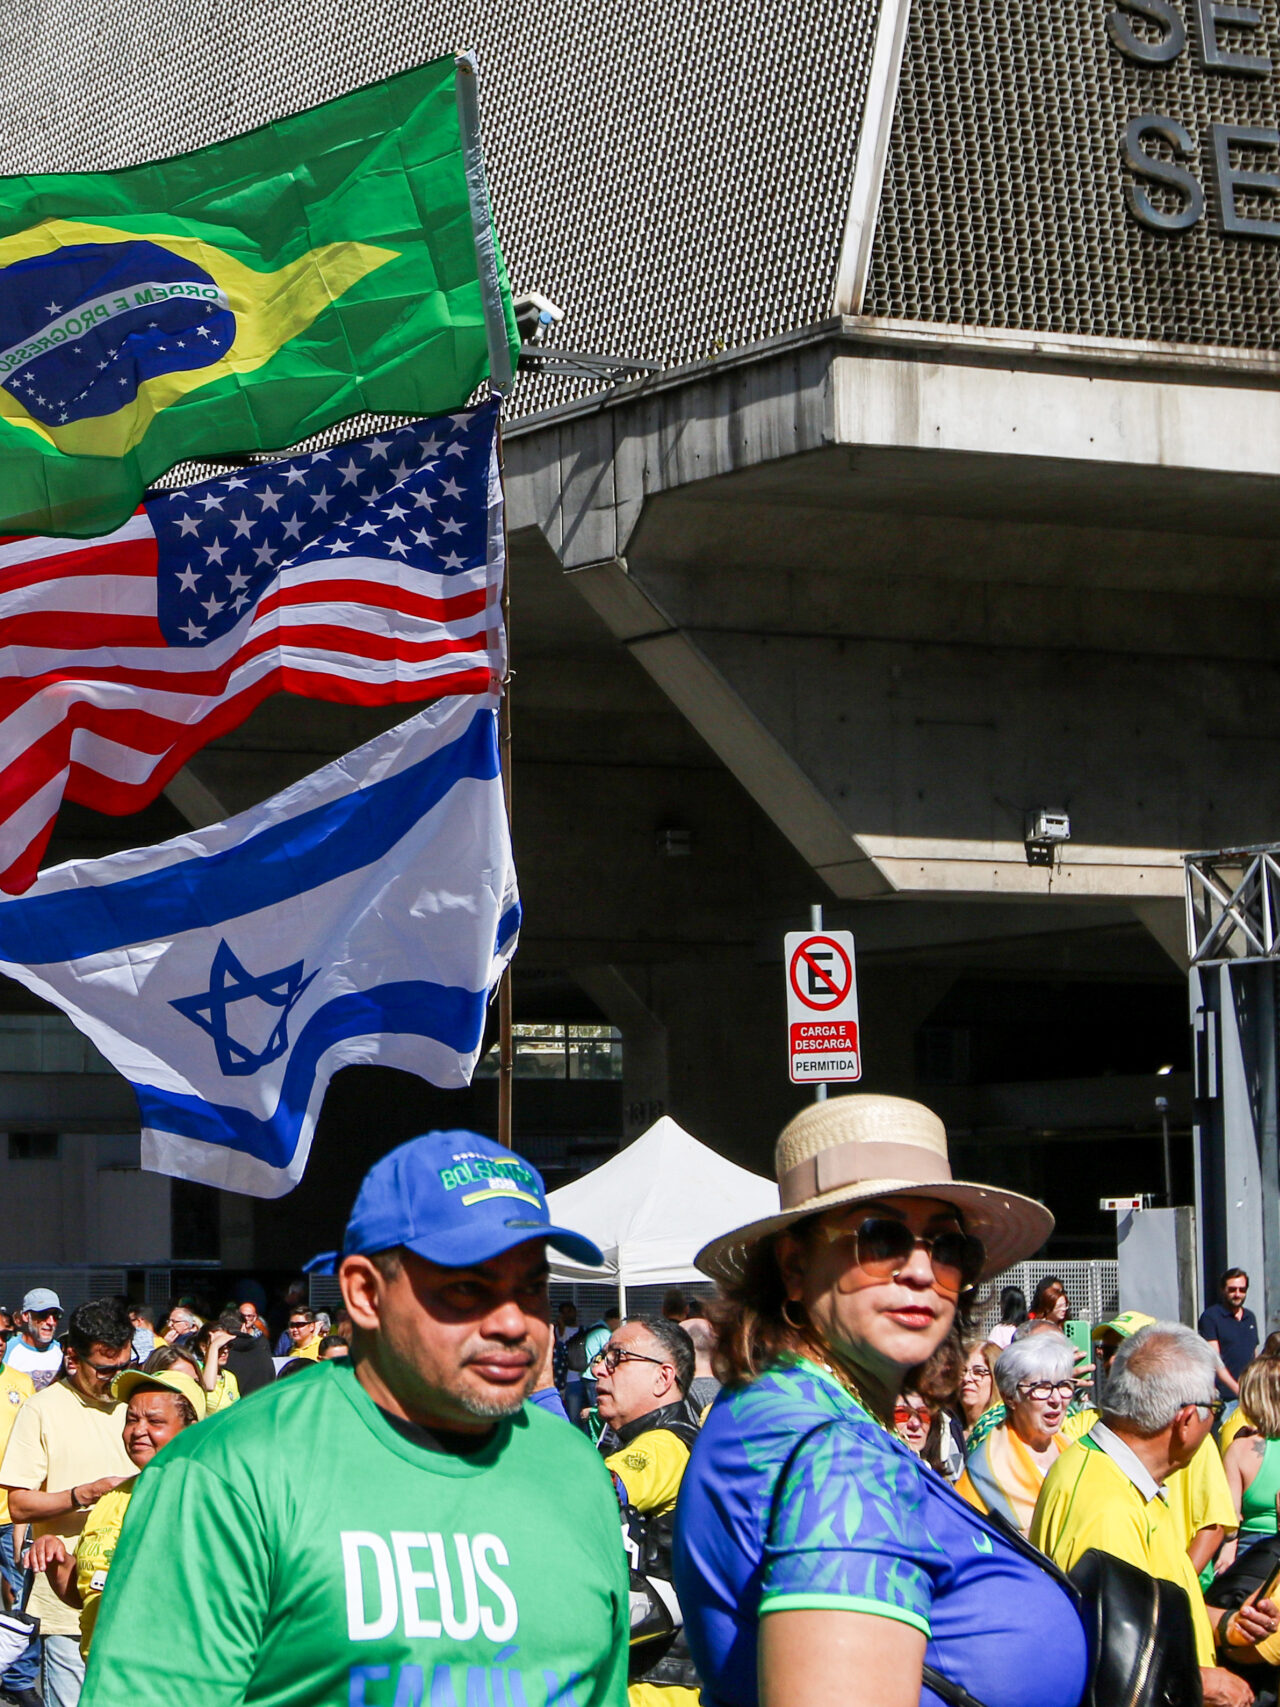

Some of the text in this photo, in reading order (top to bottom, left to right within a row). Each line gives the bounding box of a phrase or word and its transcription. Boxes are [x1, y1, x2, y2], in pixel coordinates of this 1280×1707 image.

[800, 1025, 846, 1037] CARGA E
[795, 1038, 852, 1050] DESCARGA
[795, 1060, 855, 1072] PERMITIDA
[339, 1530, 519, 1643] DEUS
